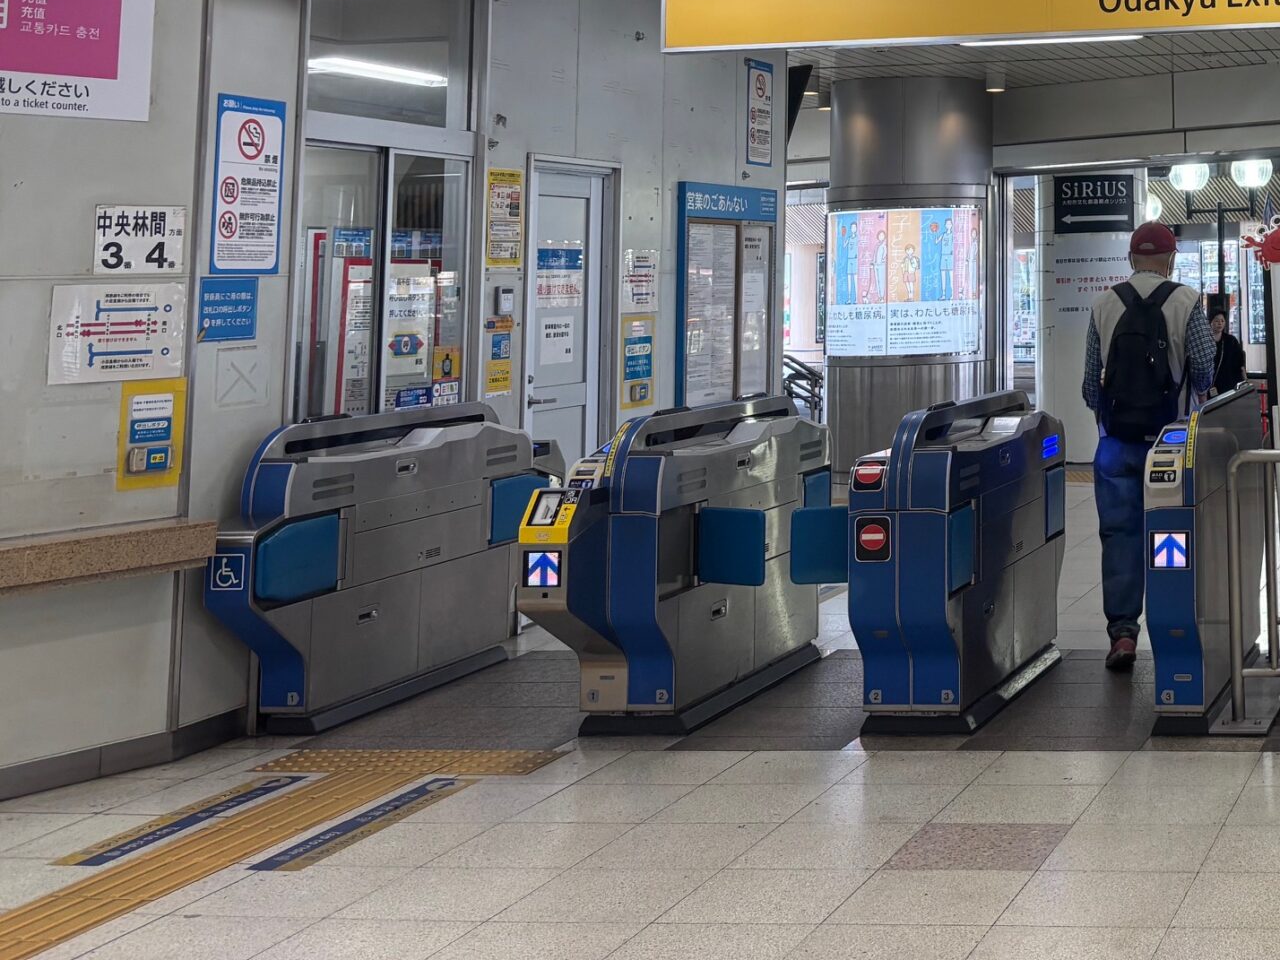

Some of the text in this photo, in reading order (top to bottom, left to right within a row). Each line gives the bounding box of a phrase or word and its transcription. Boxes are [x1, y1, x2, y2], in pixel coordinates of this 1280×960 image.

[21, 6, 46, 19] 充值
[20, 21, 100, 40] 교통카드 충전
[1, 97, 89, 112] to a ticket counter.
[1062, 181, 1127, 198] SiRiUS
[687, 191, 748, 213] 営業のごあんない
